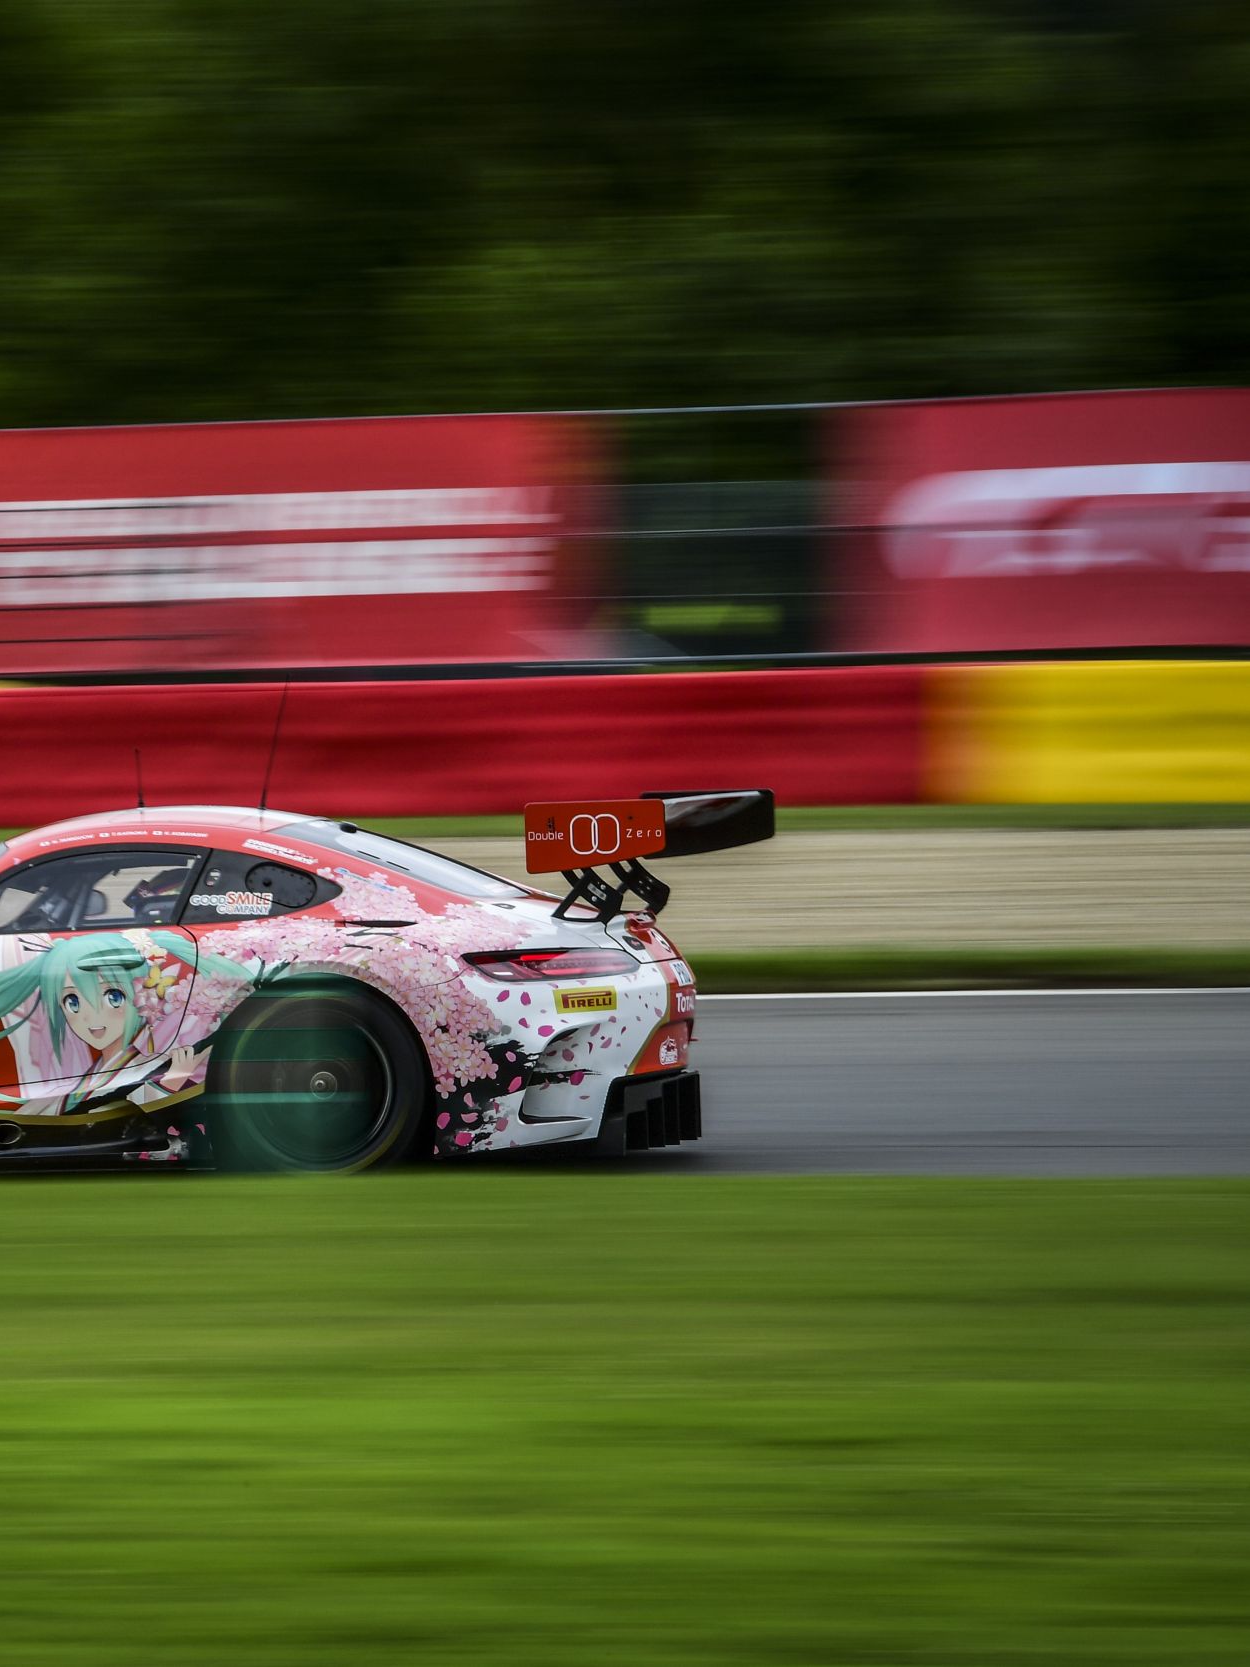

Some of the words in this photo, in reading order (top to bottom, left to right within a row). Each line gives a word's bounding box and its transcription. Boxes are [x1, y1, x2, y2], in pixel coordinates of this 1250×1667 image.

[528, 831, 564, 841] Double
[626, 829, 662, 838] Zero
[561, 991, 612, 1009] PIRELLI
